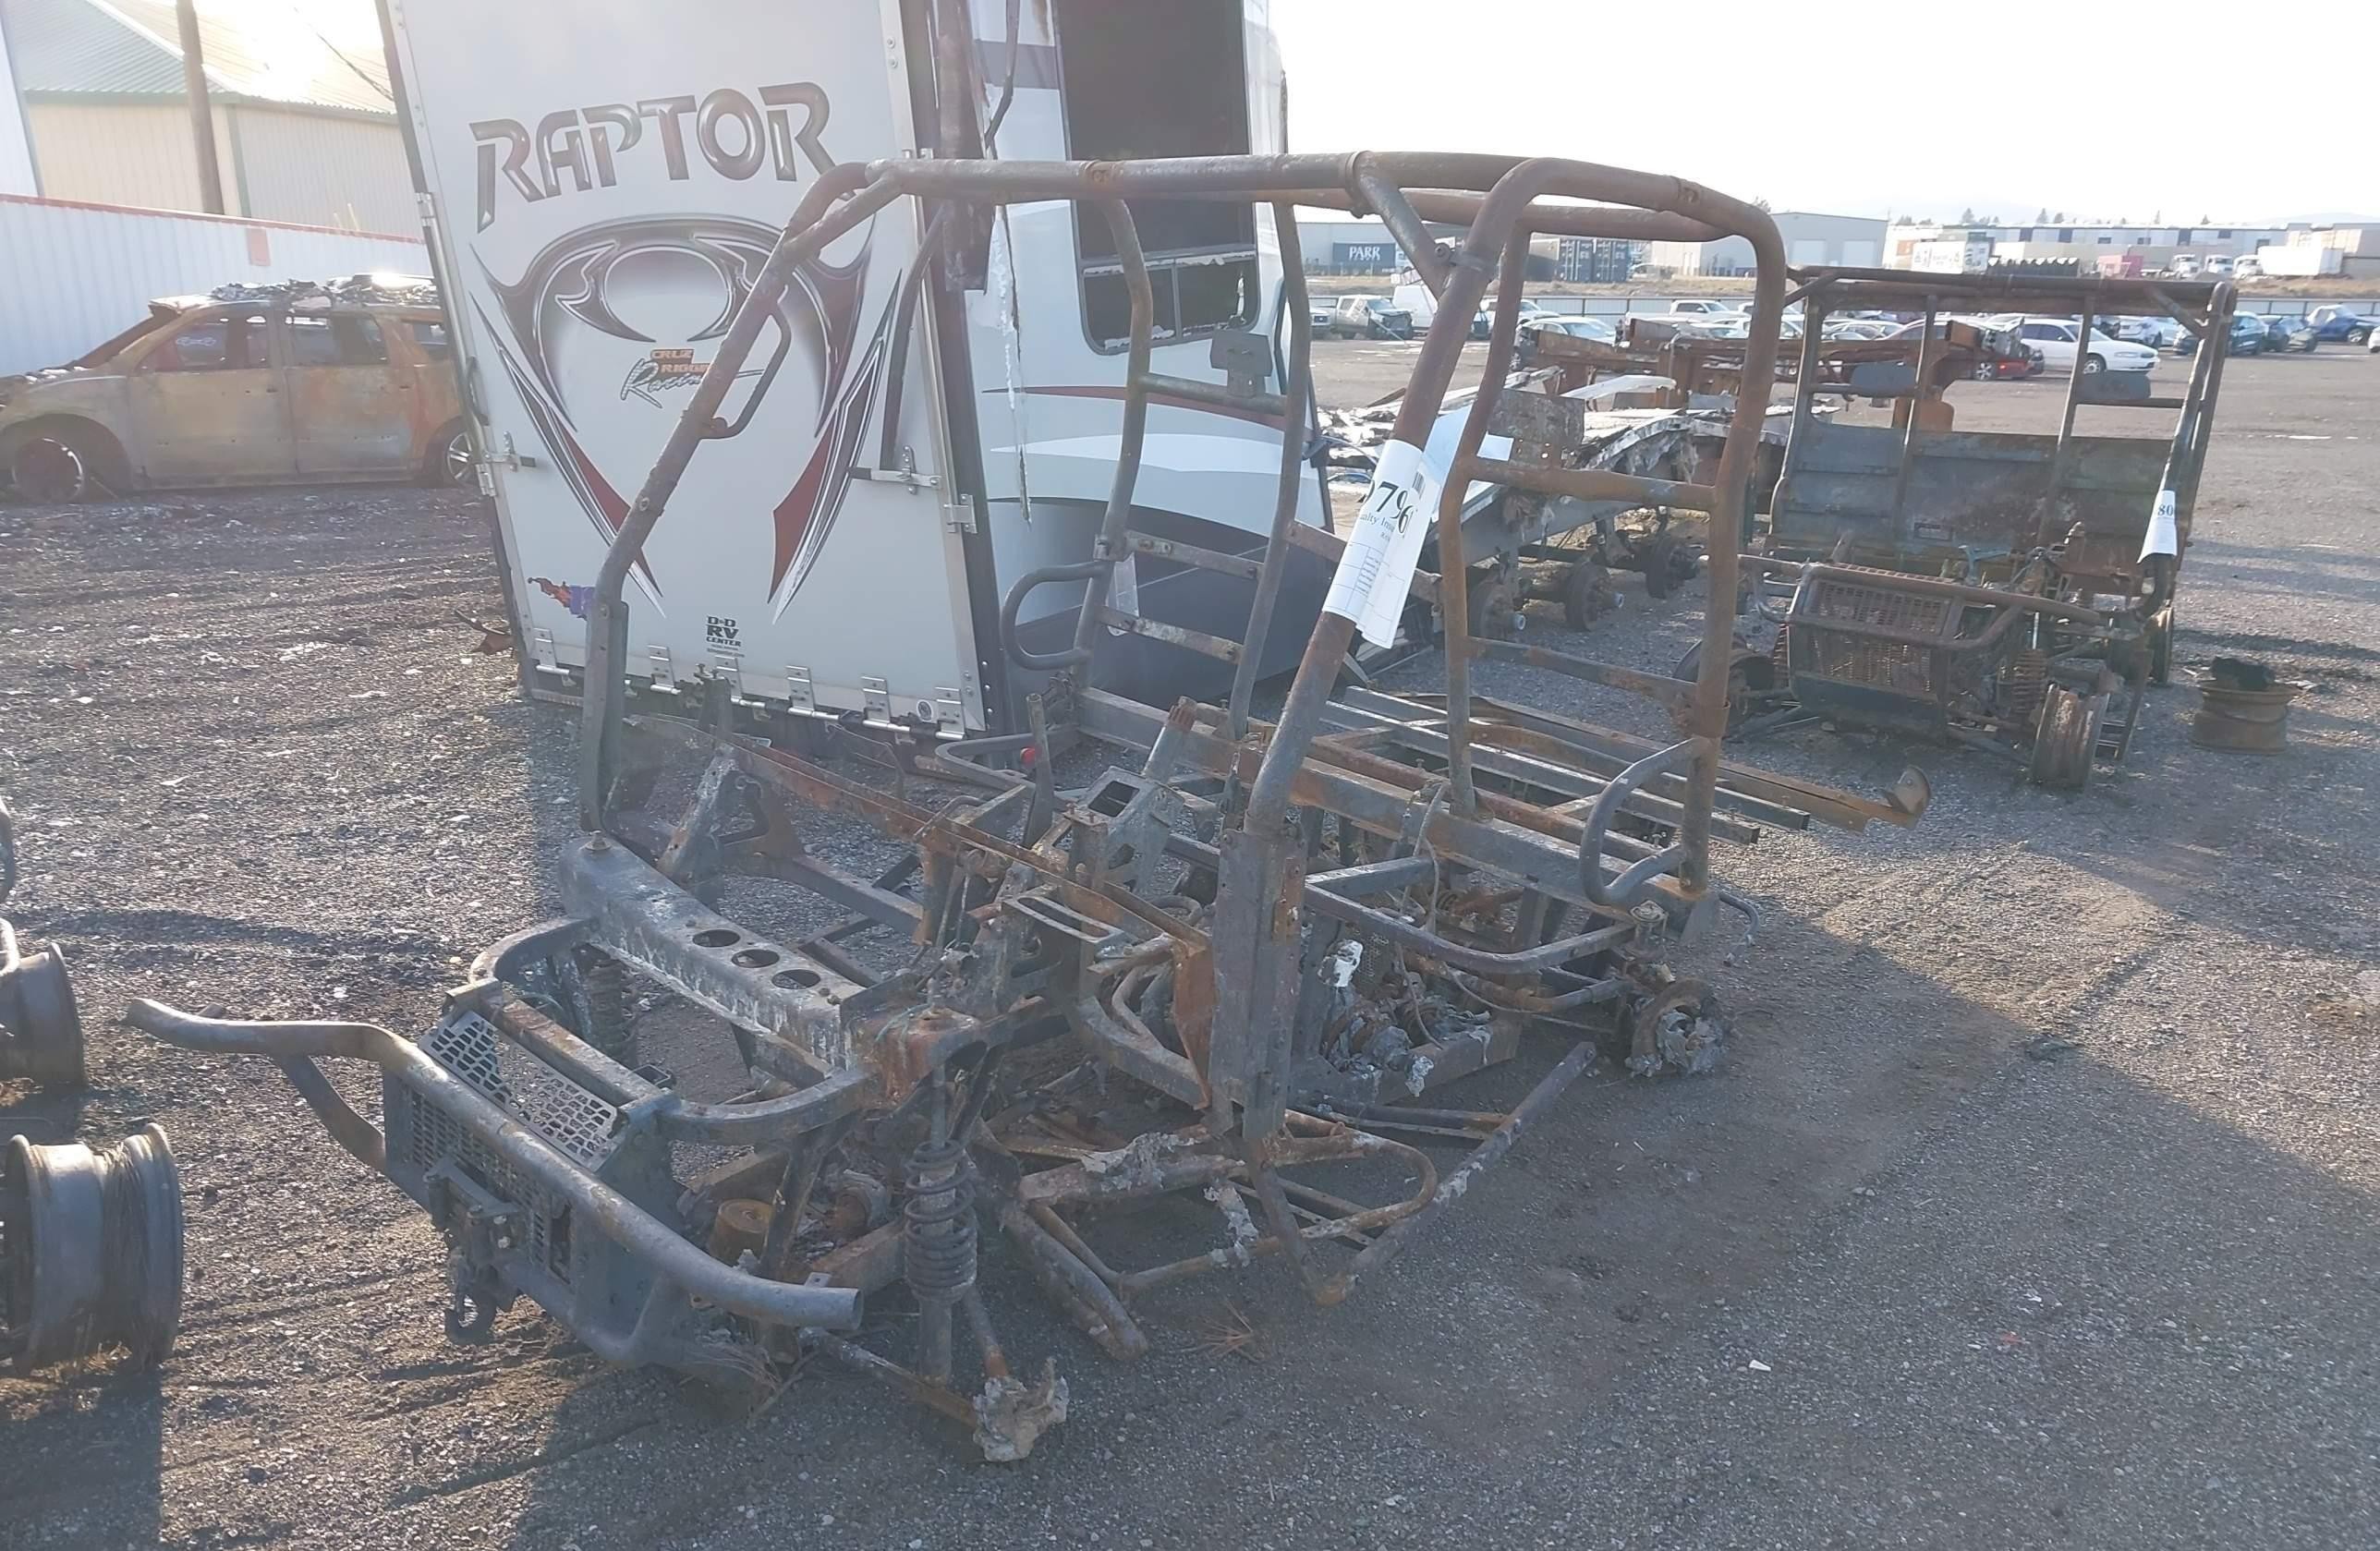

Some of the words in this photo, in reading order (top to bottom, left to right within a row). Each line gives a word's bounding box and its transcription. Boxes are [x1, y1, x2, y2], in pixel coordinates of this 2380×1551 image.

[469, 81, 836, 234] RAPTOR
[621, 357, 708, 408] Racin
[1365, 479, 1414, 534] 796
[706, 624, 739, 639] RV
[706, 636, 742, 648] CENTER
